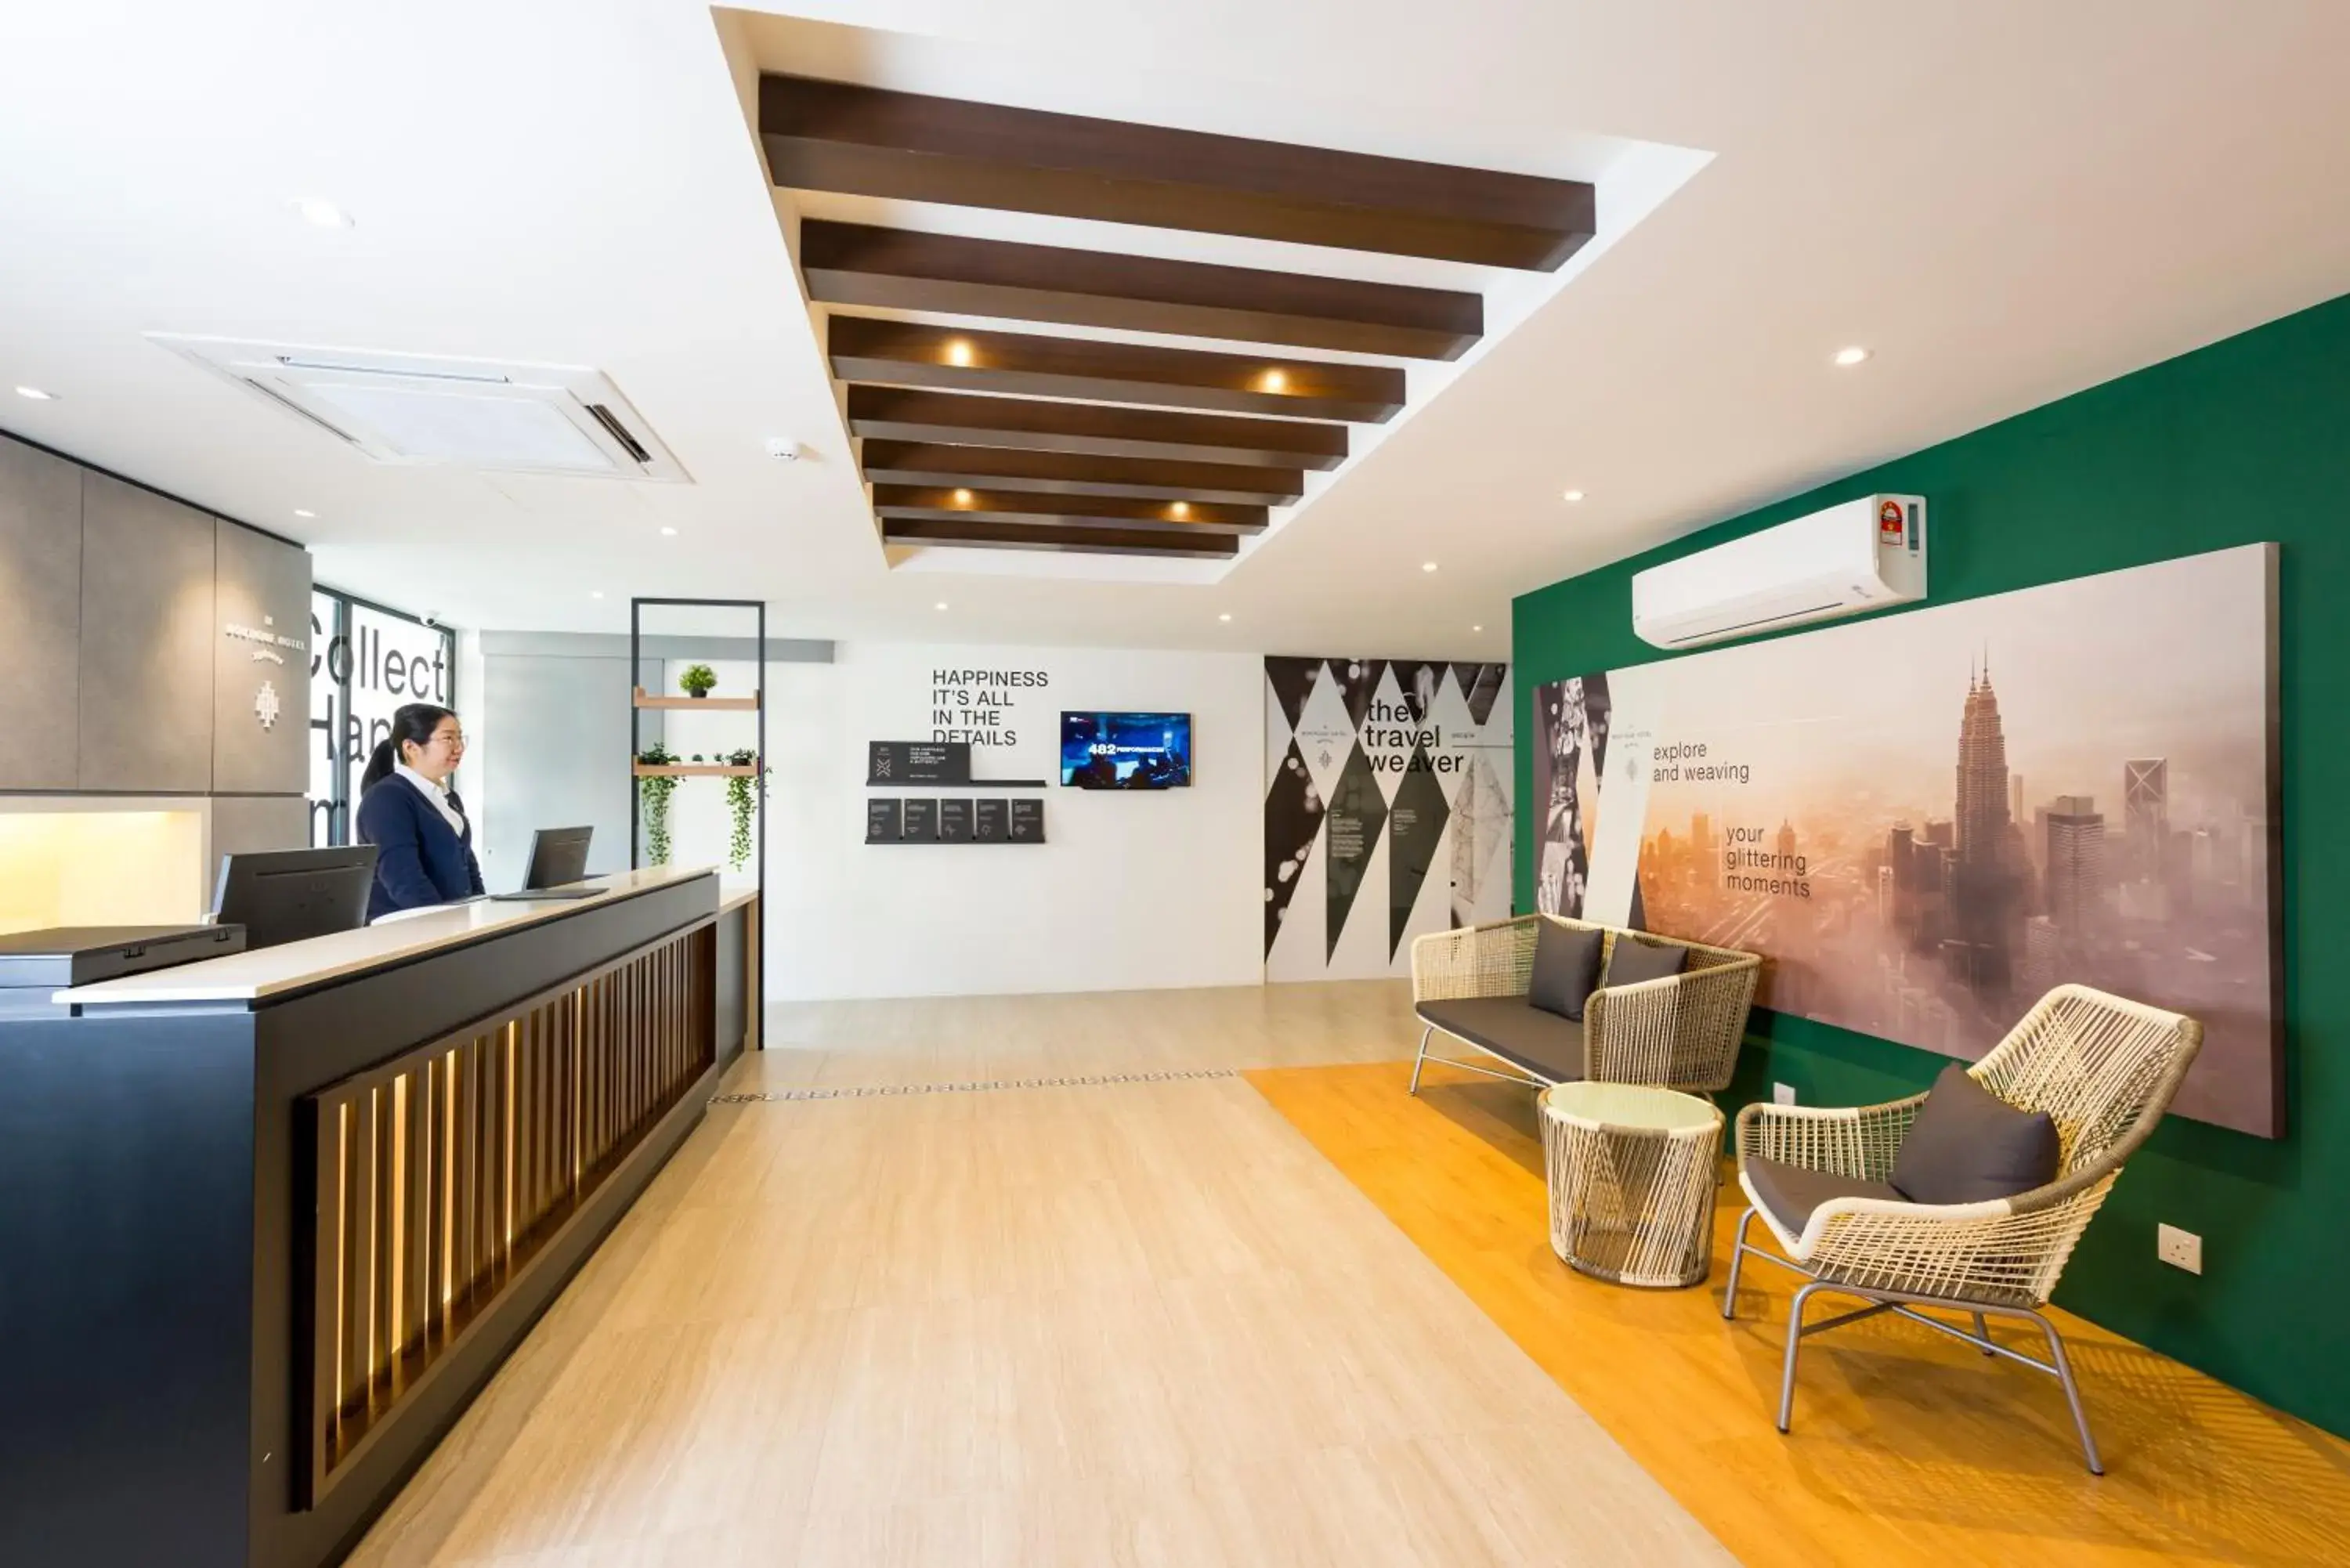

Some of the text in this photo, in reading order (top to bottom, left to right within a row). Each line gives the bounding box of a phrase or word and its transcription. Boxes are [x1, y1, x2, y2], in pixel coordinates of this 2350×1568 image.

[933, 670, 1048, 687] HAPPINESS
[933, 689, 1014, 706] IT'S ALL
[933, 709, 1000, 726] IN THE
[1368, 699, 1409, 721] the
[933, 729, 1017, 746] DETAILS
[1365, 724, 1441, 748] travel
[1088, 744, 1116, 755] 482
[1654, 741, 1707, 763] explore
[1365, 753, 1464, 773] weaver
[1654, 762, 1749, 784] and weaving
[1726, 826, 1765, 847] your
[1726, 847, 1806, 876] glittering
[1726, 874, 1811, 898] moments
